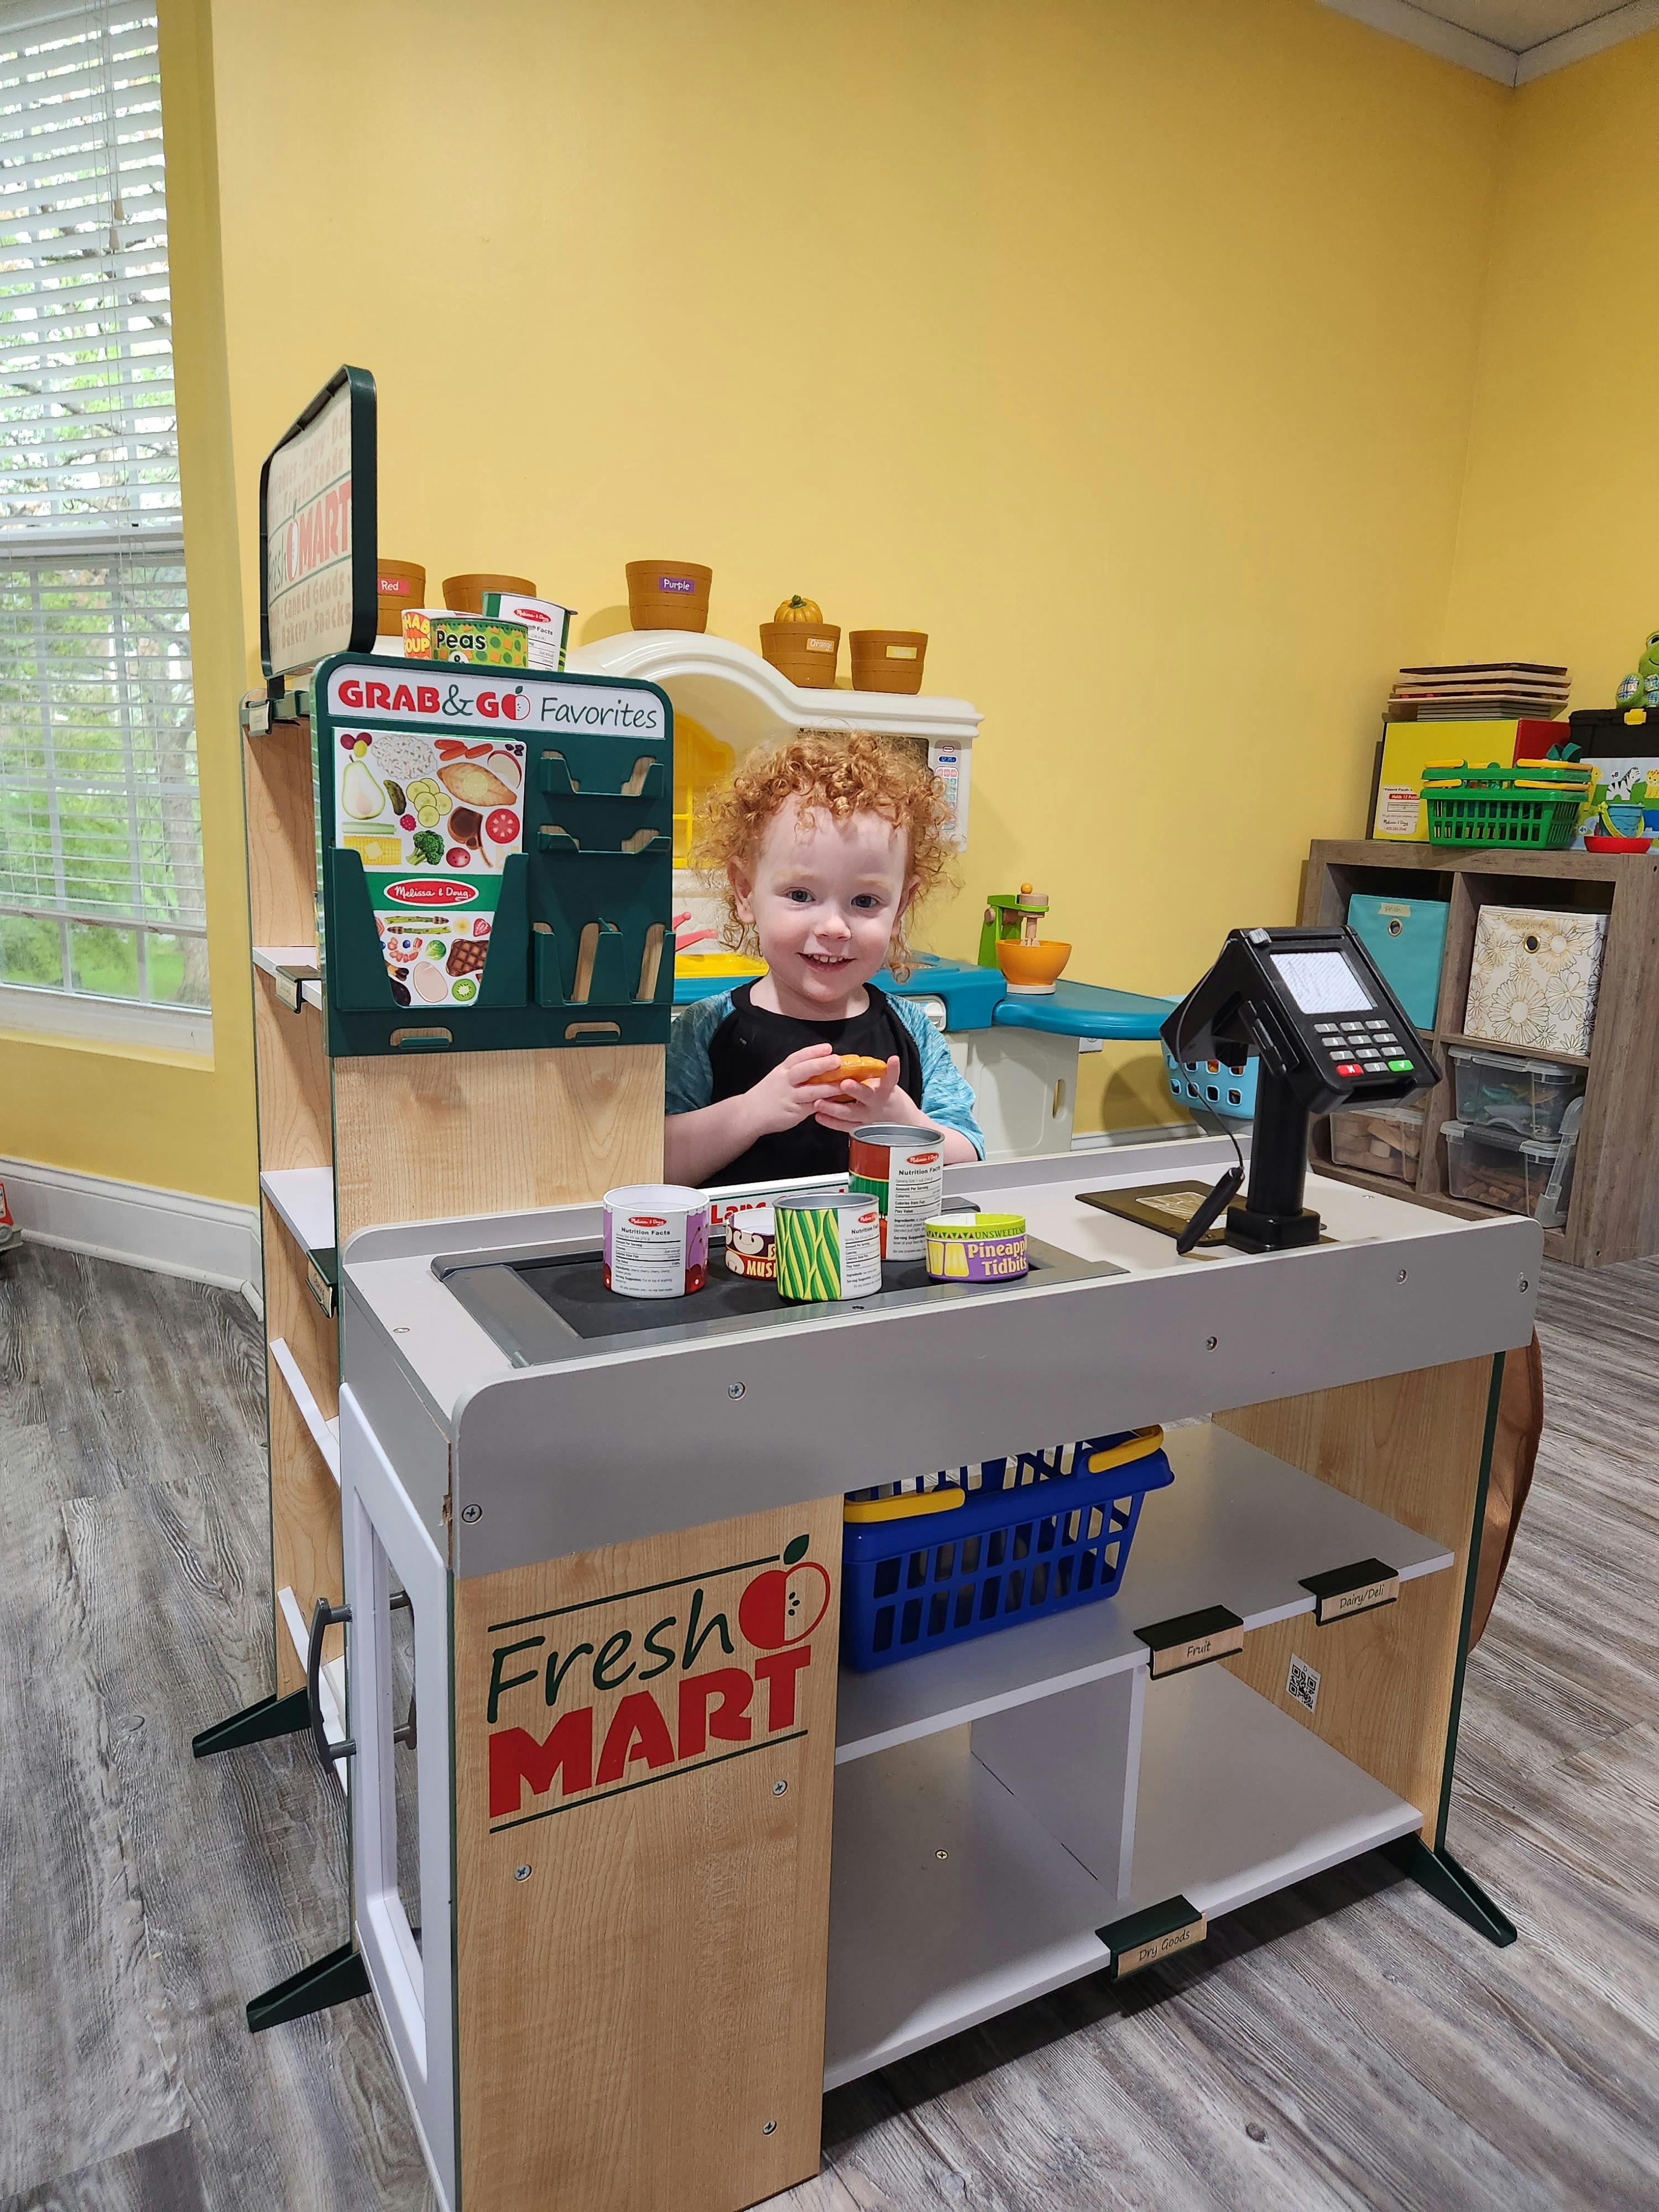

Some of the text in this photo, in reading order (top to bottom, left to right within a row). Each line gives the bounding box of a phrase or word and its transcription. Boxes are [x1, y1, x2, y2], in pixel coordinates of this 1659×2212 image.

[298, 479, 351, 576] MART
[284, 585, 310, 620] Canned
[313, 570, 345, 606] Goods
[381, 580, 399, 591] Red
[664, 578, 690, 591] Purple
[281, 619, 307, 649] Bakery
[314, 600, 351, 635] Snacks
[536, 626, 554, 635] Facts
[404, 637, 430, 654] OUP
[436, 629, 487, 651] Peas
[810, 639, 832, 651] Orange
[540, 697, 658, 729] Favorites
[394, 885, 436, 899] Melissa
[446, 886, 469, 901] Doug
[621, 1227, 649, 1235] Nutrition
[852, 1226, 873, 1234] Nutrition
[981, 1255, 1027, 1276] Tidbits
[1340, 1584, 1384, 1609] Dairy/Deli
[487, 1589, 734, 1724] Fresh
[1187, 1640, 1212, 1658] Fruit
[489, 1645, 811, 1818] MART
[1139, 1929, 1190, 1961] Dry Goods
